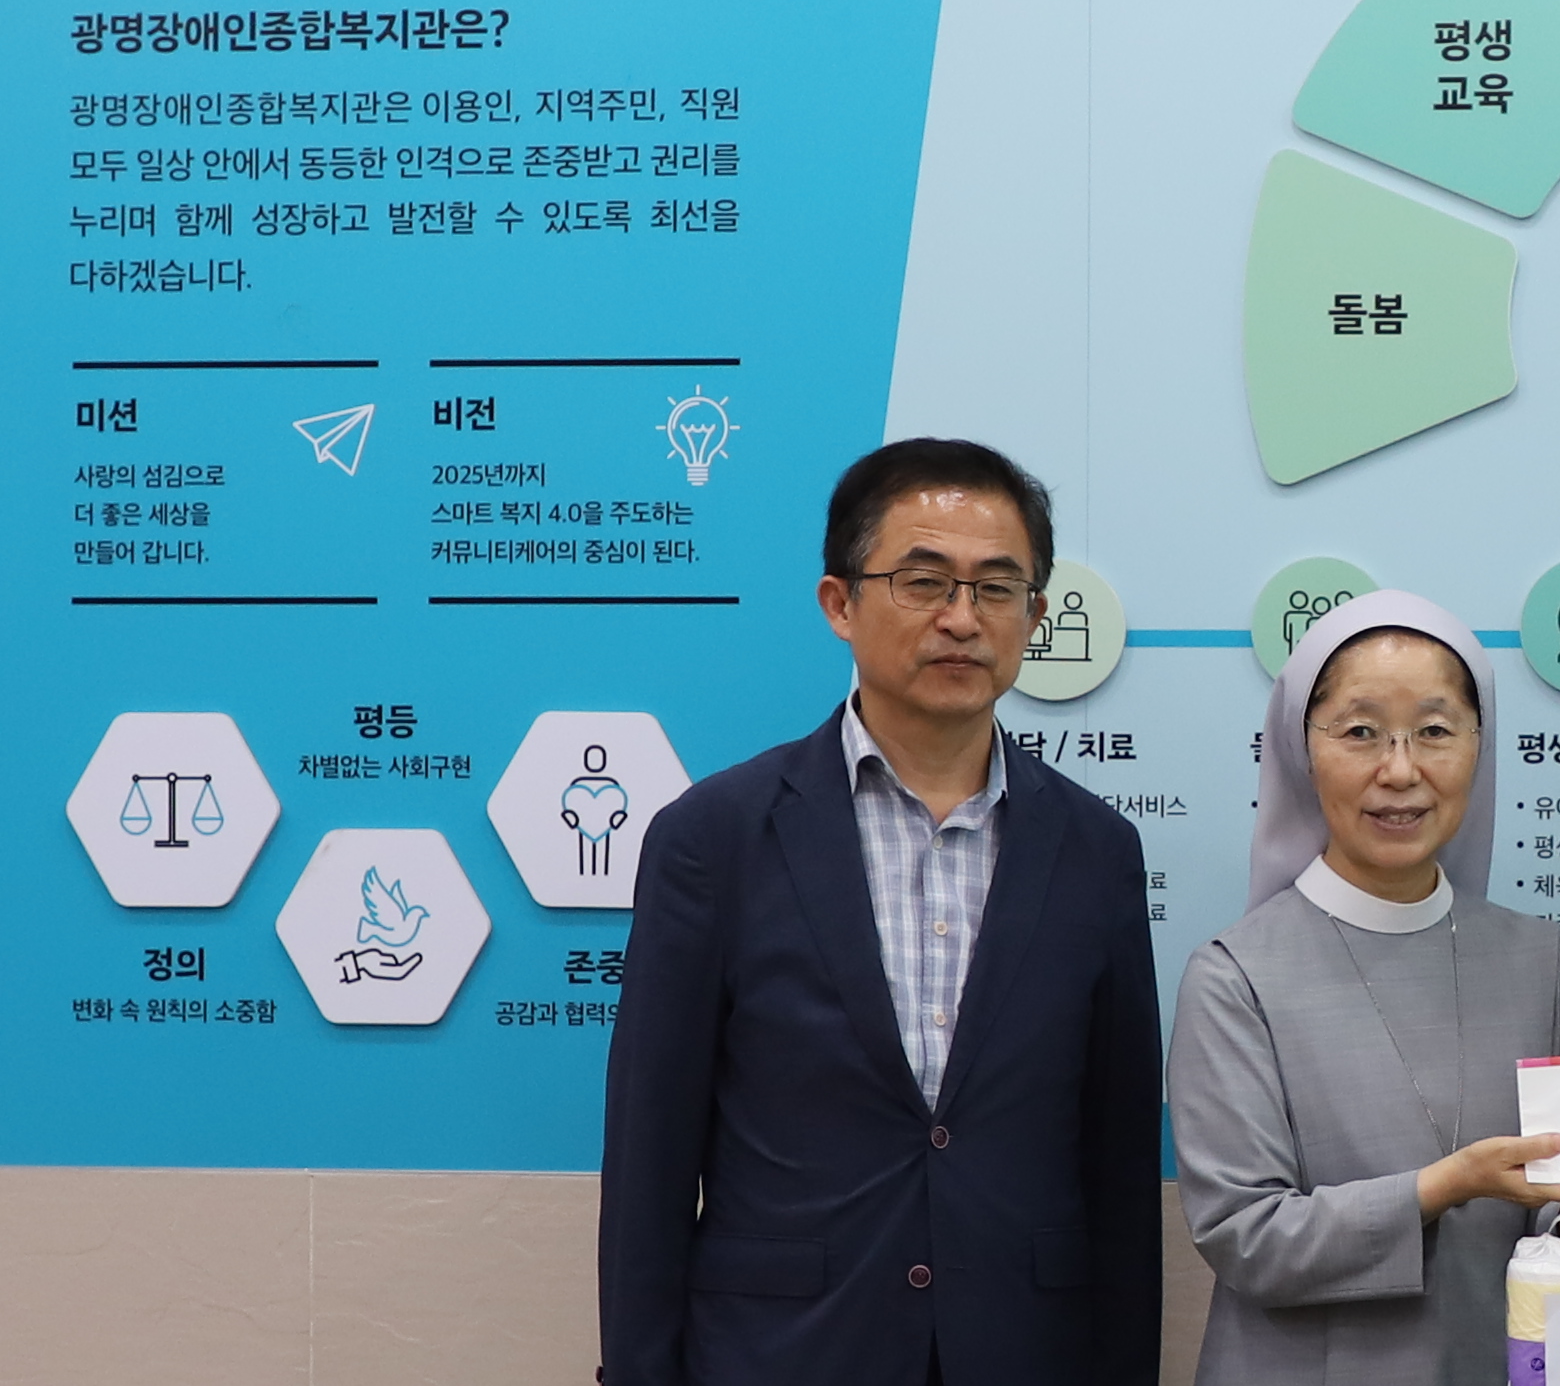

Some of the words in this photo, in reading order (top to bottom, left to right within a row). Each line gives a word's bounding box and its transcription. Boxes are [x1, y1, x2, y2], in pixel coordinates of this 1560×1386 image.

[71, 9, 509, 54] 광명장애인종합복지관은?
[1435, 20, 1511, 61] 평생
[71, 91, 412, 127] 광명장애인종합복지관은
[423, 90, 520, 123] 이용인,
[537, 88, 664, 122] 지역주민,
[682, 88, 738, 120] 직원
[1434, 74, 1513, 114] 교육
[70, 151, 127, 181] 모두
[137, 149, 194, 181] 일상
[203, 148, 288, 180] 안에서
[300, 147, 387, 180] 동등한
[397, 146, 514, 178] 인격으로
[524, 145, 641, 177] 존중받고
[651, 144, 740, 176] 권리를
[70, 204, 155, 237] 누리며
[176, 204, 232, 236] 함께
[253, 203, 369, 236] 성장하고
[389, 202, 476, 235] 발전할
[496, 202, 523, 234] 수
[544, 200, 631, 233] 있도록
[651, 200, 739, 232] 최선을
[71, 259, 251, 292] 다하겠습니다.
[1328, 295, 1408, 335] 돌봄
[77, 399, 137, 432] 미션
[434, 397, 495, 430] 비전
[75, 465, 135, 488] 사랑의
[144, 465, 224, 488] 섬김으로
[433, 463, 545, 487] 2025년까지
[75, 503, 93, 526] 더
[102, 503, 141, 526] 좋은
[149, 503, 210, 526] 세상을
[432, 502, 493, 525] 스마트
[501, 502, 540, 525] 복지
[548, 501, 603, 525] 4.0을
[610, 501, 693, 525] 주도하는
[75, 541, 134, 564] 만들어
[143, 541, 208, 564] 갑니다.
[432, 540, 576, 564] 커뮤니티케어의
[584, 540, 645, 563] 중심이
[653, 540, 699, 563] 된다.
[354, 705, 417, 739] 평등
[299, 755, 381, 778] 차별없는
[389, 755, 470, 778] 사회구현
[144, 948, 204, 981] 정의
[73, 999, 113, 1021] 변화
[121, 999, 139, 1022] 속
[147, 999, 207, 1023] 원칙의
[215, 1000, 276, 1023] 소중함
[495, 1002, 558, 1026] 공감과
